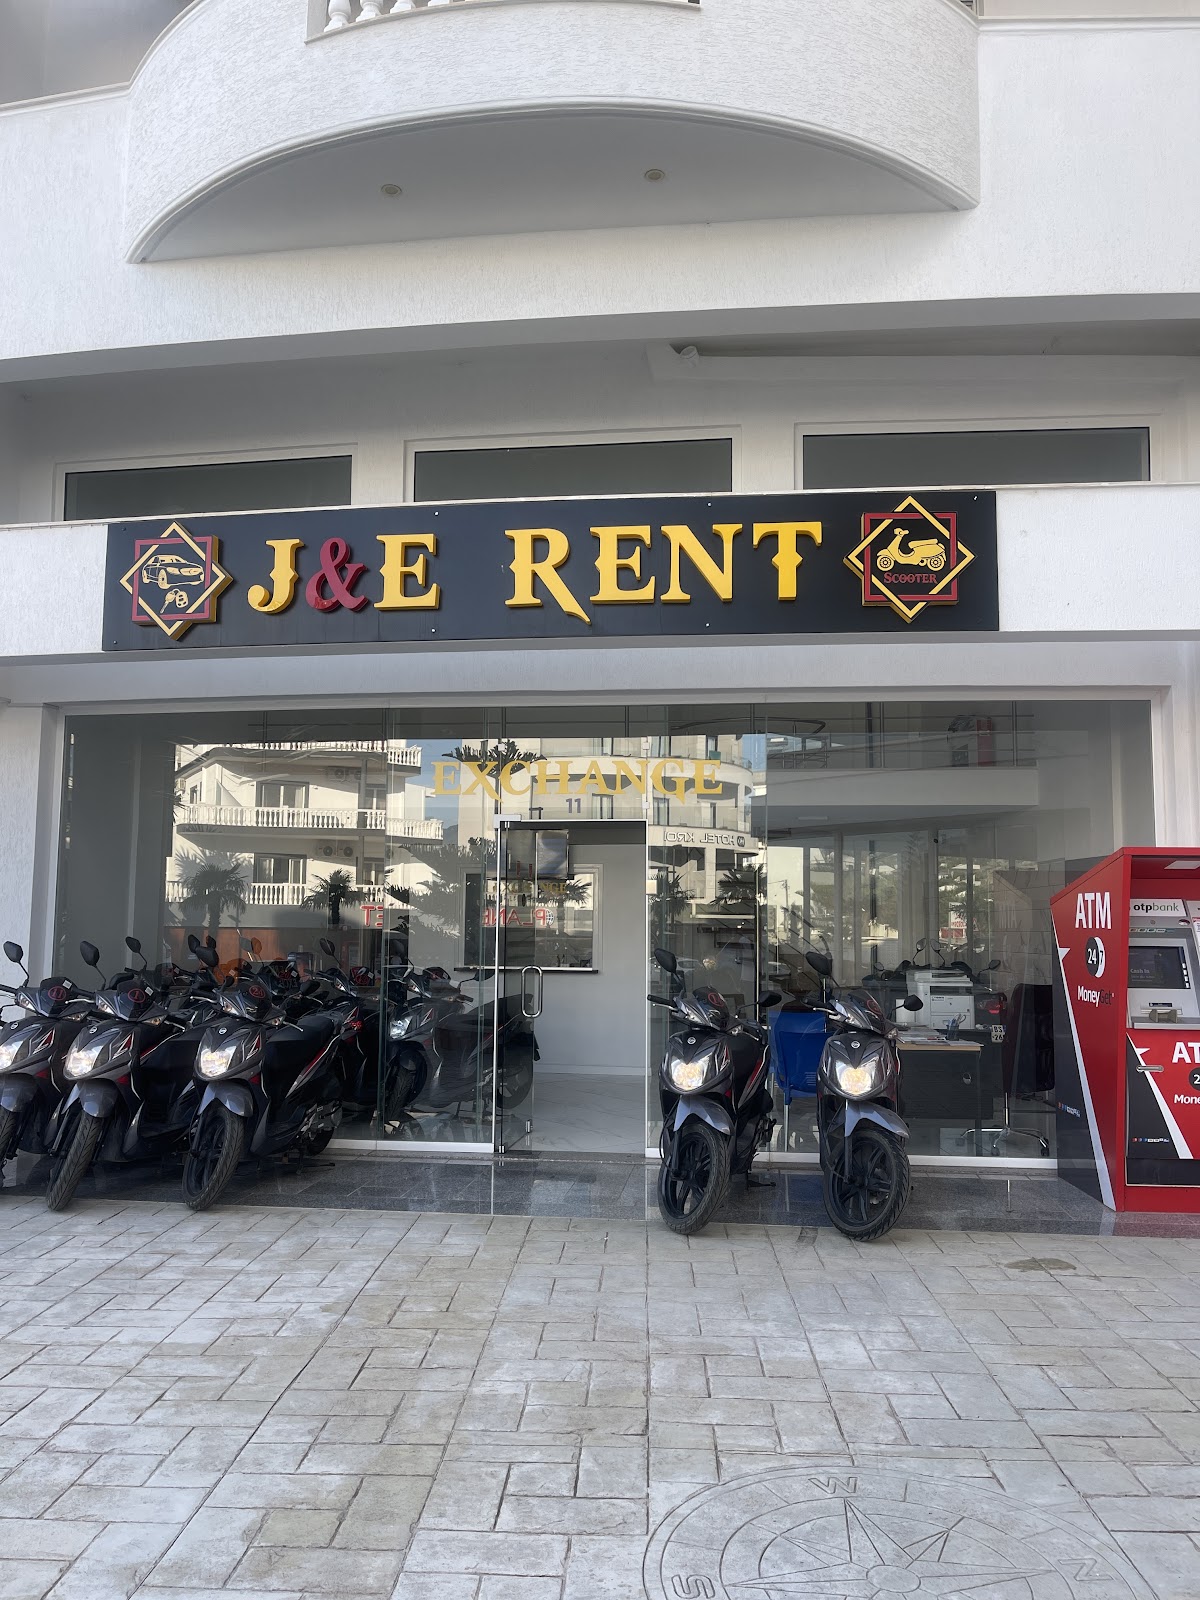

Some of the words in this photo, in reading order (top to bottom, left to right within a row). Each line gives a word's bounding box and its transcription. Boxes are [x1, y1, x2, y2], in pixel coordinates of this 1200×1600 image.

[247, 533, 440, 615] J&E
[504, 521, 823, 626] RENT
[883, 572, 937, 584] SCOOTER
[430, 759, 723, 804] EXCHANGE
[566, 798, 581, 814] 11
[1075, 891, 1112, 930] ATM
[1133, 902, 1180, 914] otpbank
[1087, 948, 1097, 965] 24
